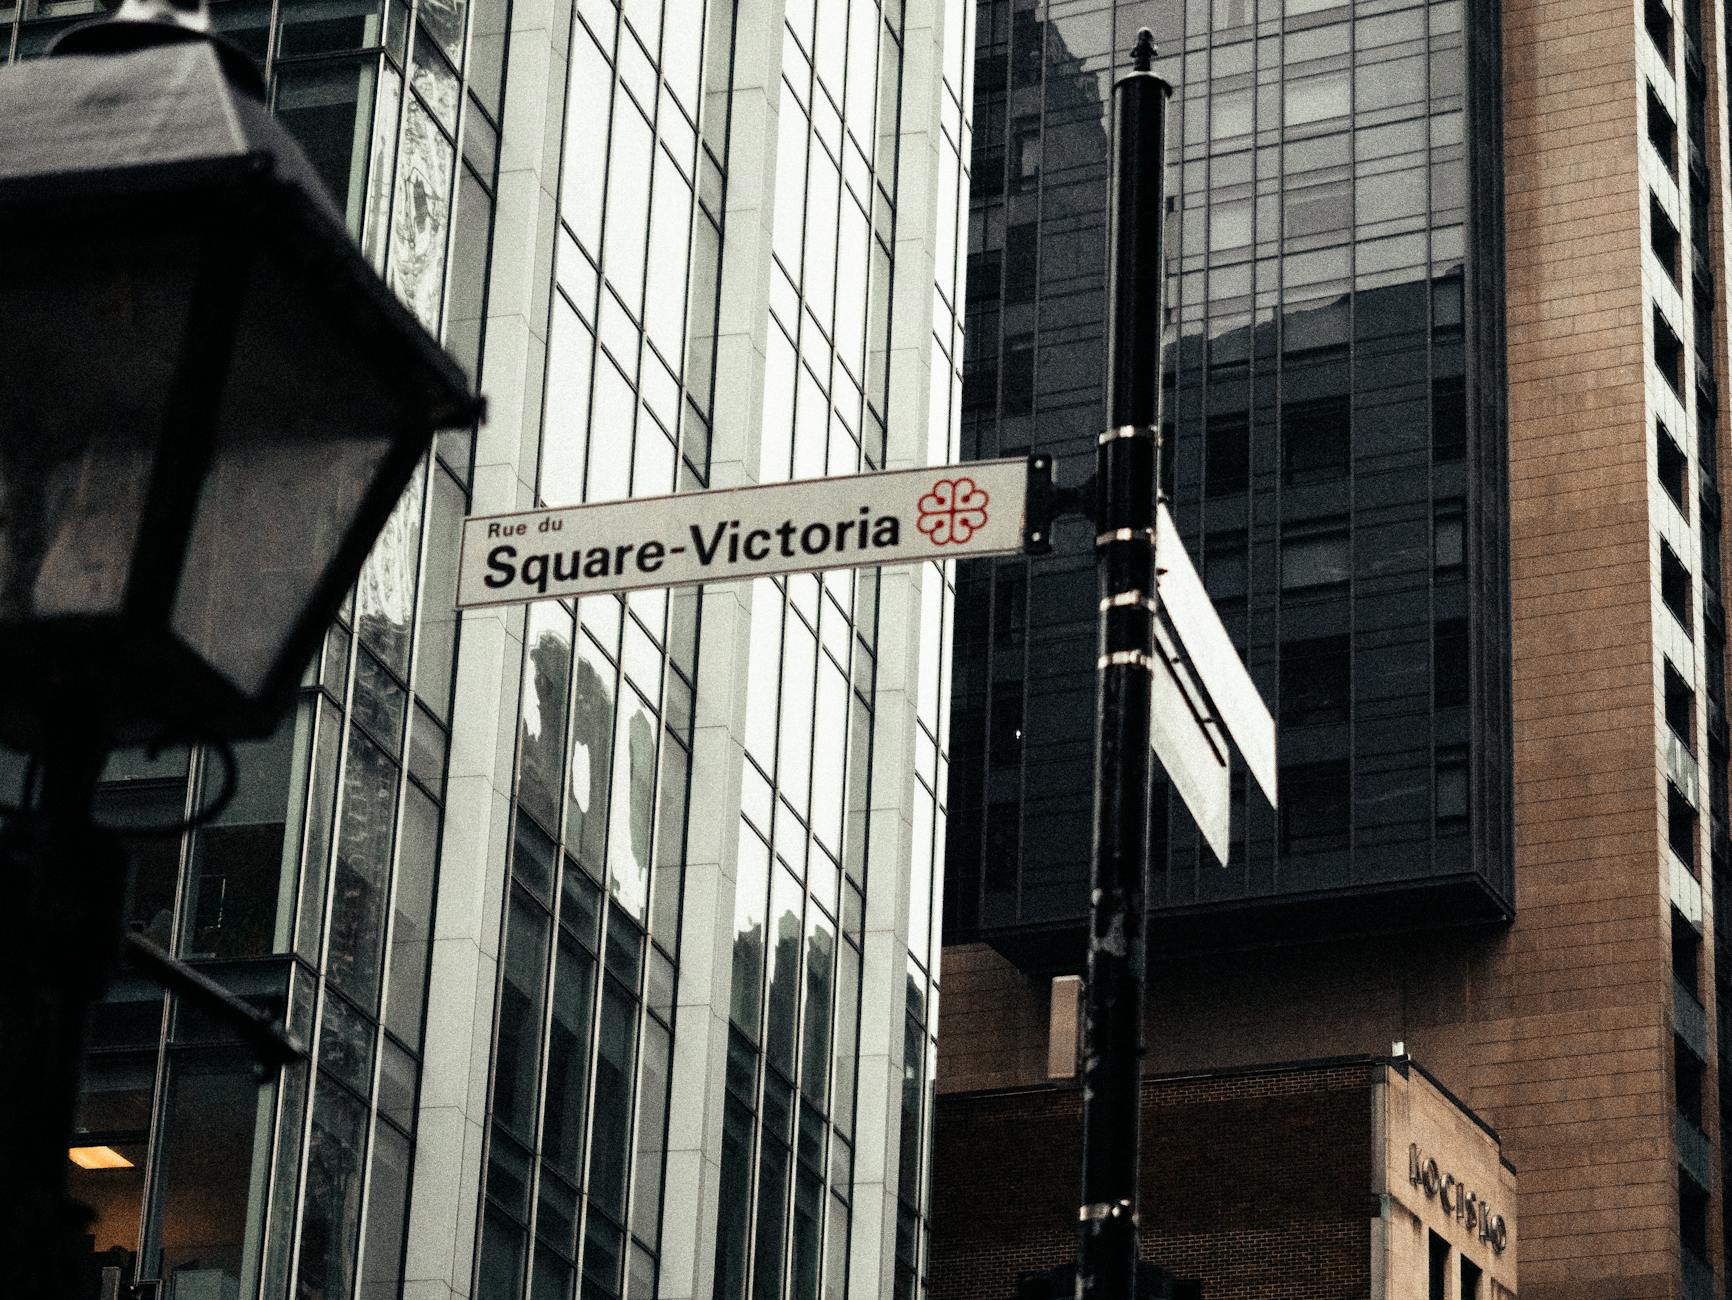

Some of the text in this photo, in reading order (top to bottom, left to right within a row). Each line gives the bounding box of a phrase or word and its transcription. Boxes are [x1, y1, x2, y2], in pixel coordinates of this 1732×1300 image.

[483, 506, 901, 593] Square-Victoria
[488, 517, 563, 538] Rue du
